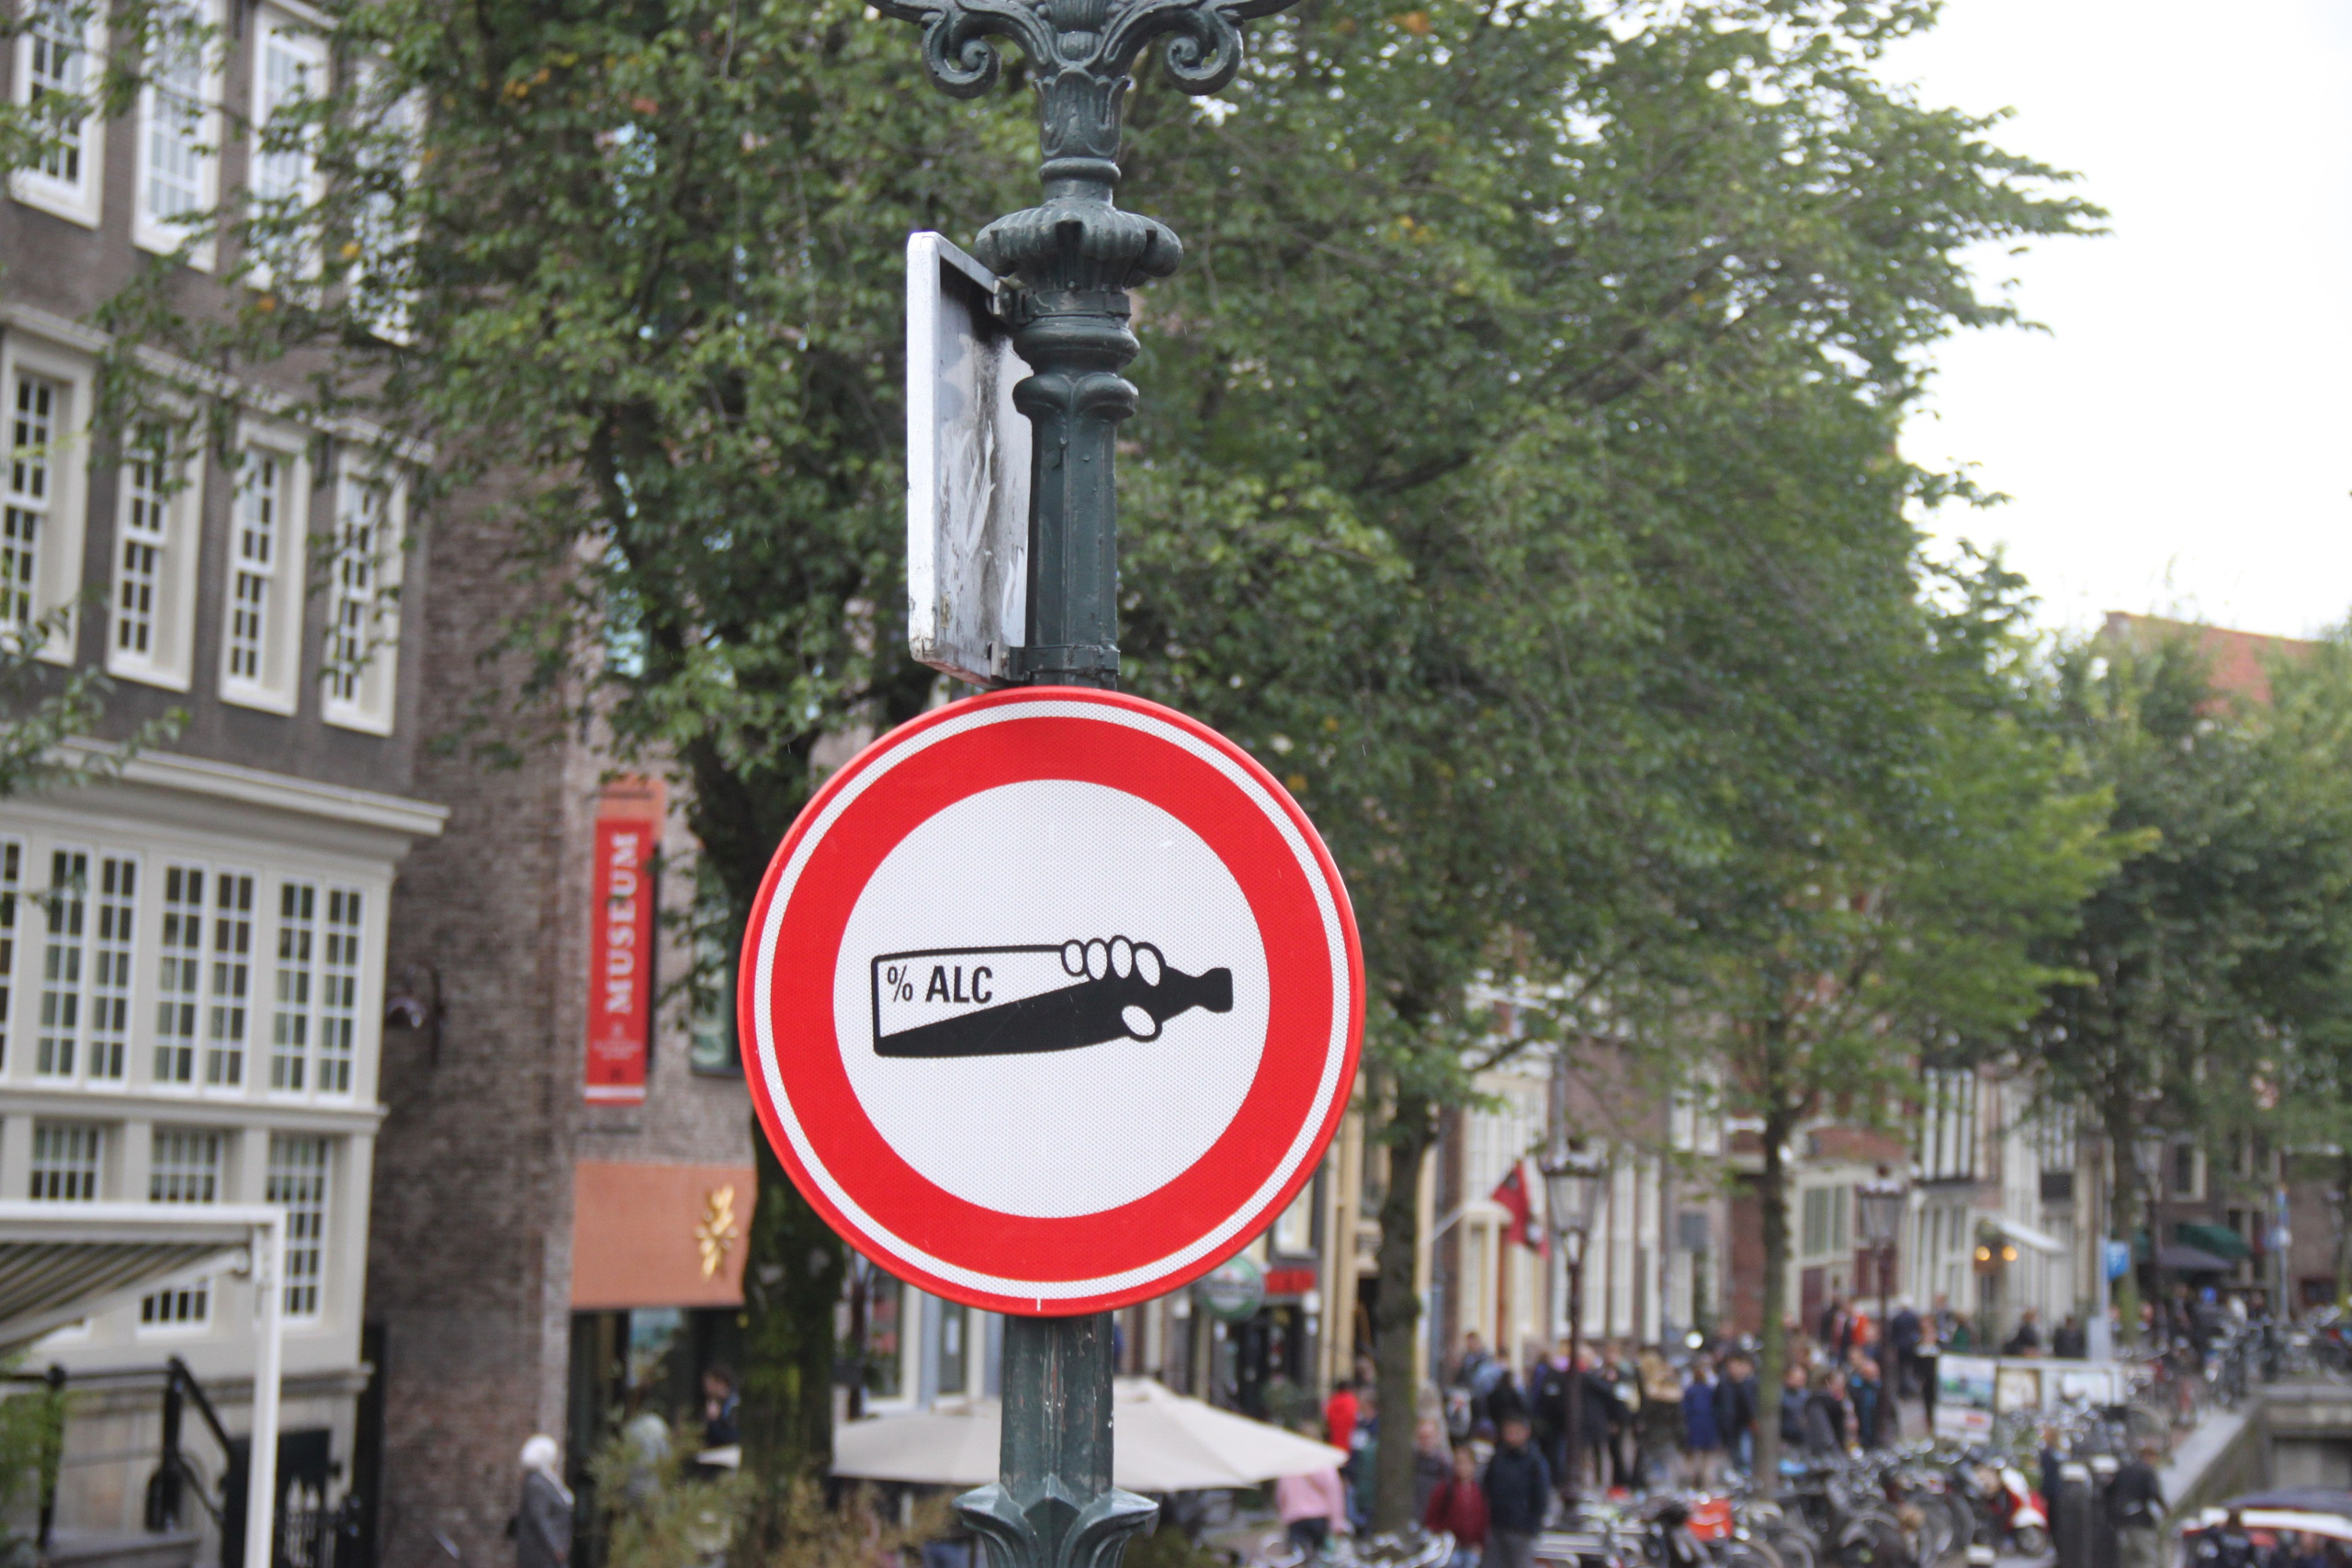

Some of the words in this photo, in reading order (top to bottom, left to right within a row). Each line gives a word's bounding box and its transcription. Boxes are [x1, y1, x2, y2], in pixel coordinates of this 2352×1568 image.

[605, 832, 639, 1014] MUSEUM
[887, 964, 913, 1002] %
[925, 964, 992, 1004] ALC
